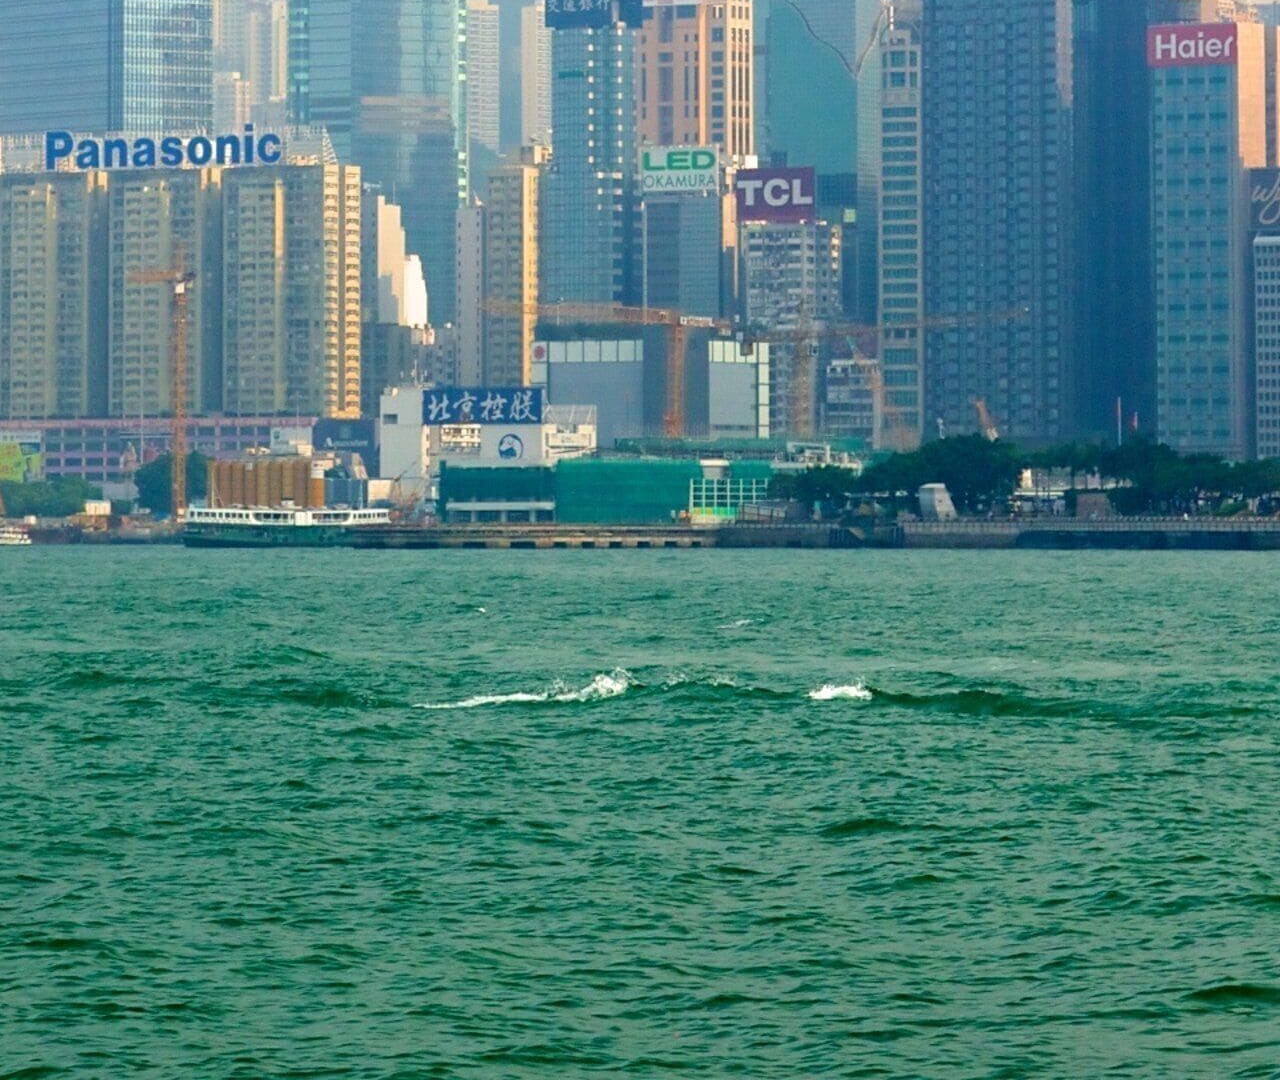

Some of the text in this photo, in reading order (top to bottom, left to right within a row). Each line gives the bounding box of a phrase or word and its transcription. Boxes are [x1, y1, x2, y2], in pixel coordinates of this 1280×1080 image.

[1155, 31, 1234, 60] Haier
[46, 123, 282, 170] Panasonic
[642, 150, 716, 170] LED
[643, 174, 716, 188] OKAMURA
[737, 178, 813, 206] TCL
[428, 392, 538, 421] 北京控股
